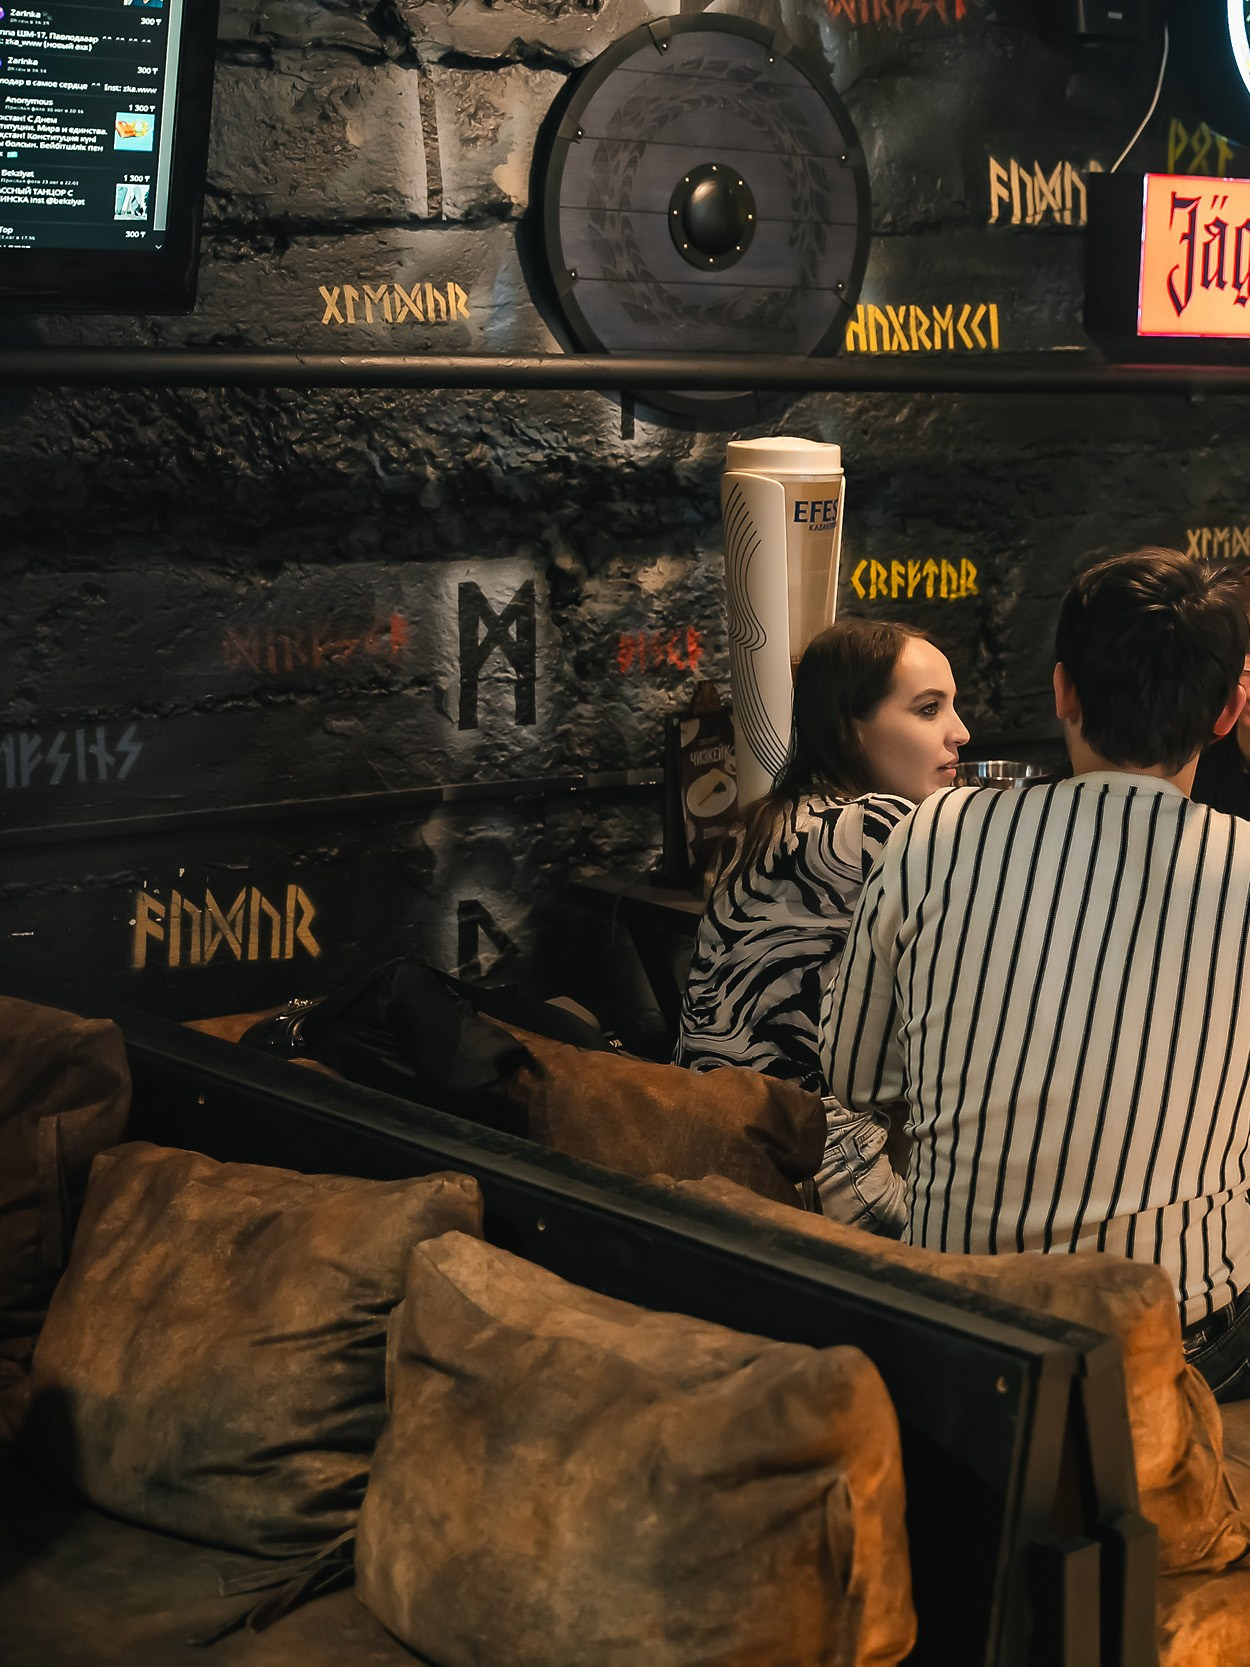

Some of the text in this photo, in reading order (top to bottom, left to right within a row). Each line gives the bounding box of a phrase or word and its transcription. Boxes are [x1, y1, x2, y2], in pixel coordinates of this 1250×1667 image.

[10, 8, 41, 18] Zarinka
[8, 56, 38, 66] Zarinka
[59, 82, 88, 90] сердце
[5, 96, 53, 106] Anonymous
[37, 124, 60, 133] Мира
[27, 133, 79, 142] Конституция
[5, 140, 38, 148] болсын.
[33, 188, 66, 196] ТАНЦОР
[690, 743, 731, 767] ЧИЗКЕЙК
